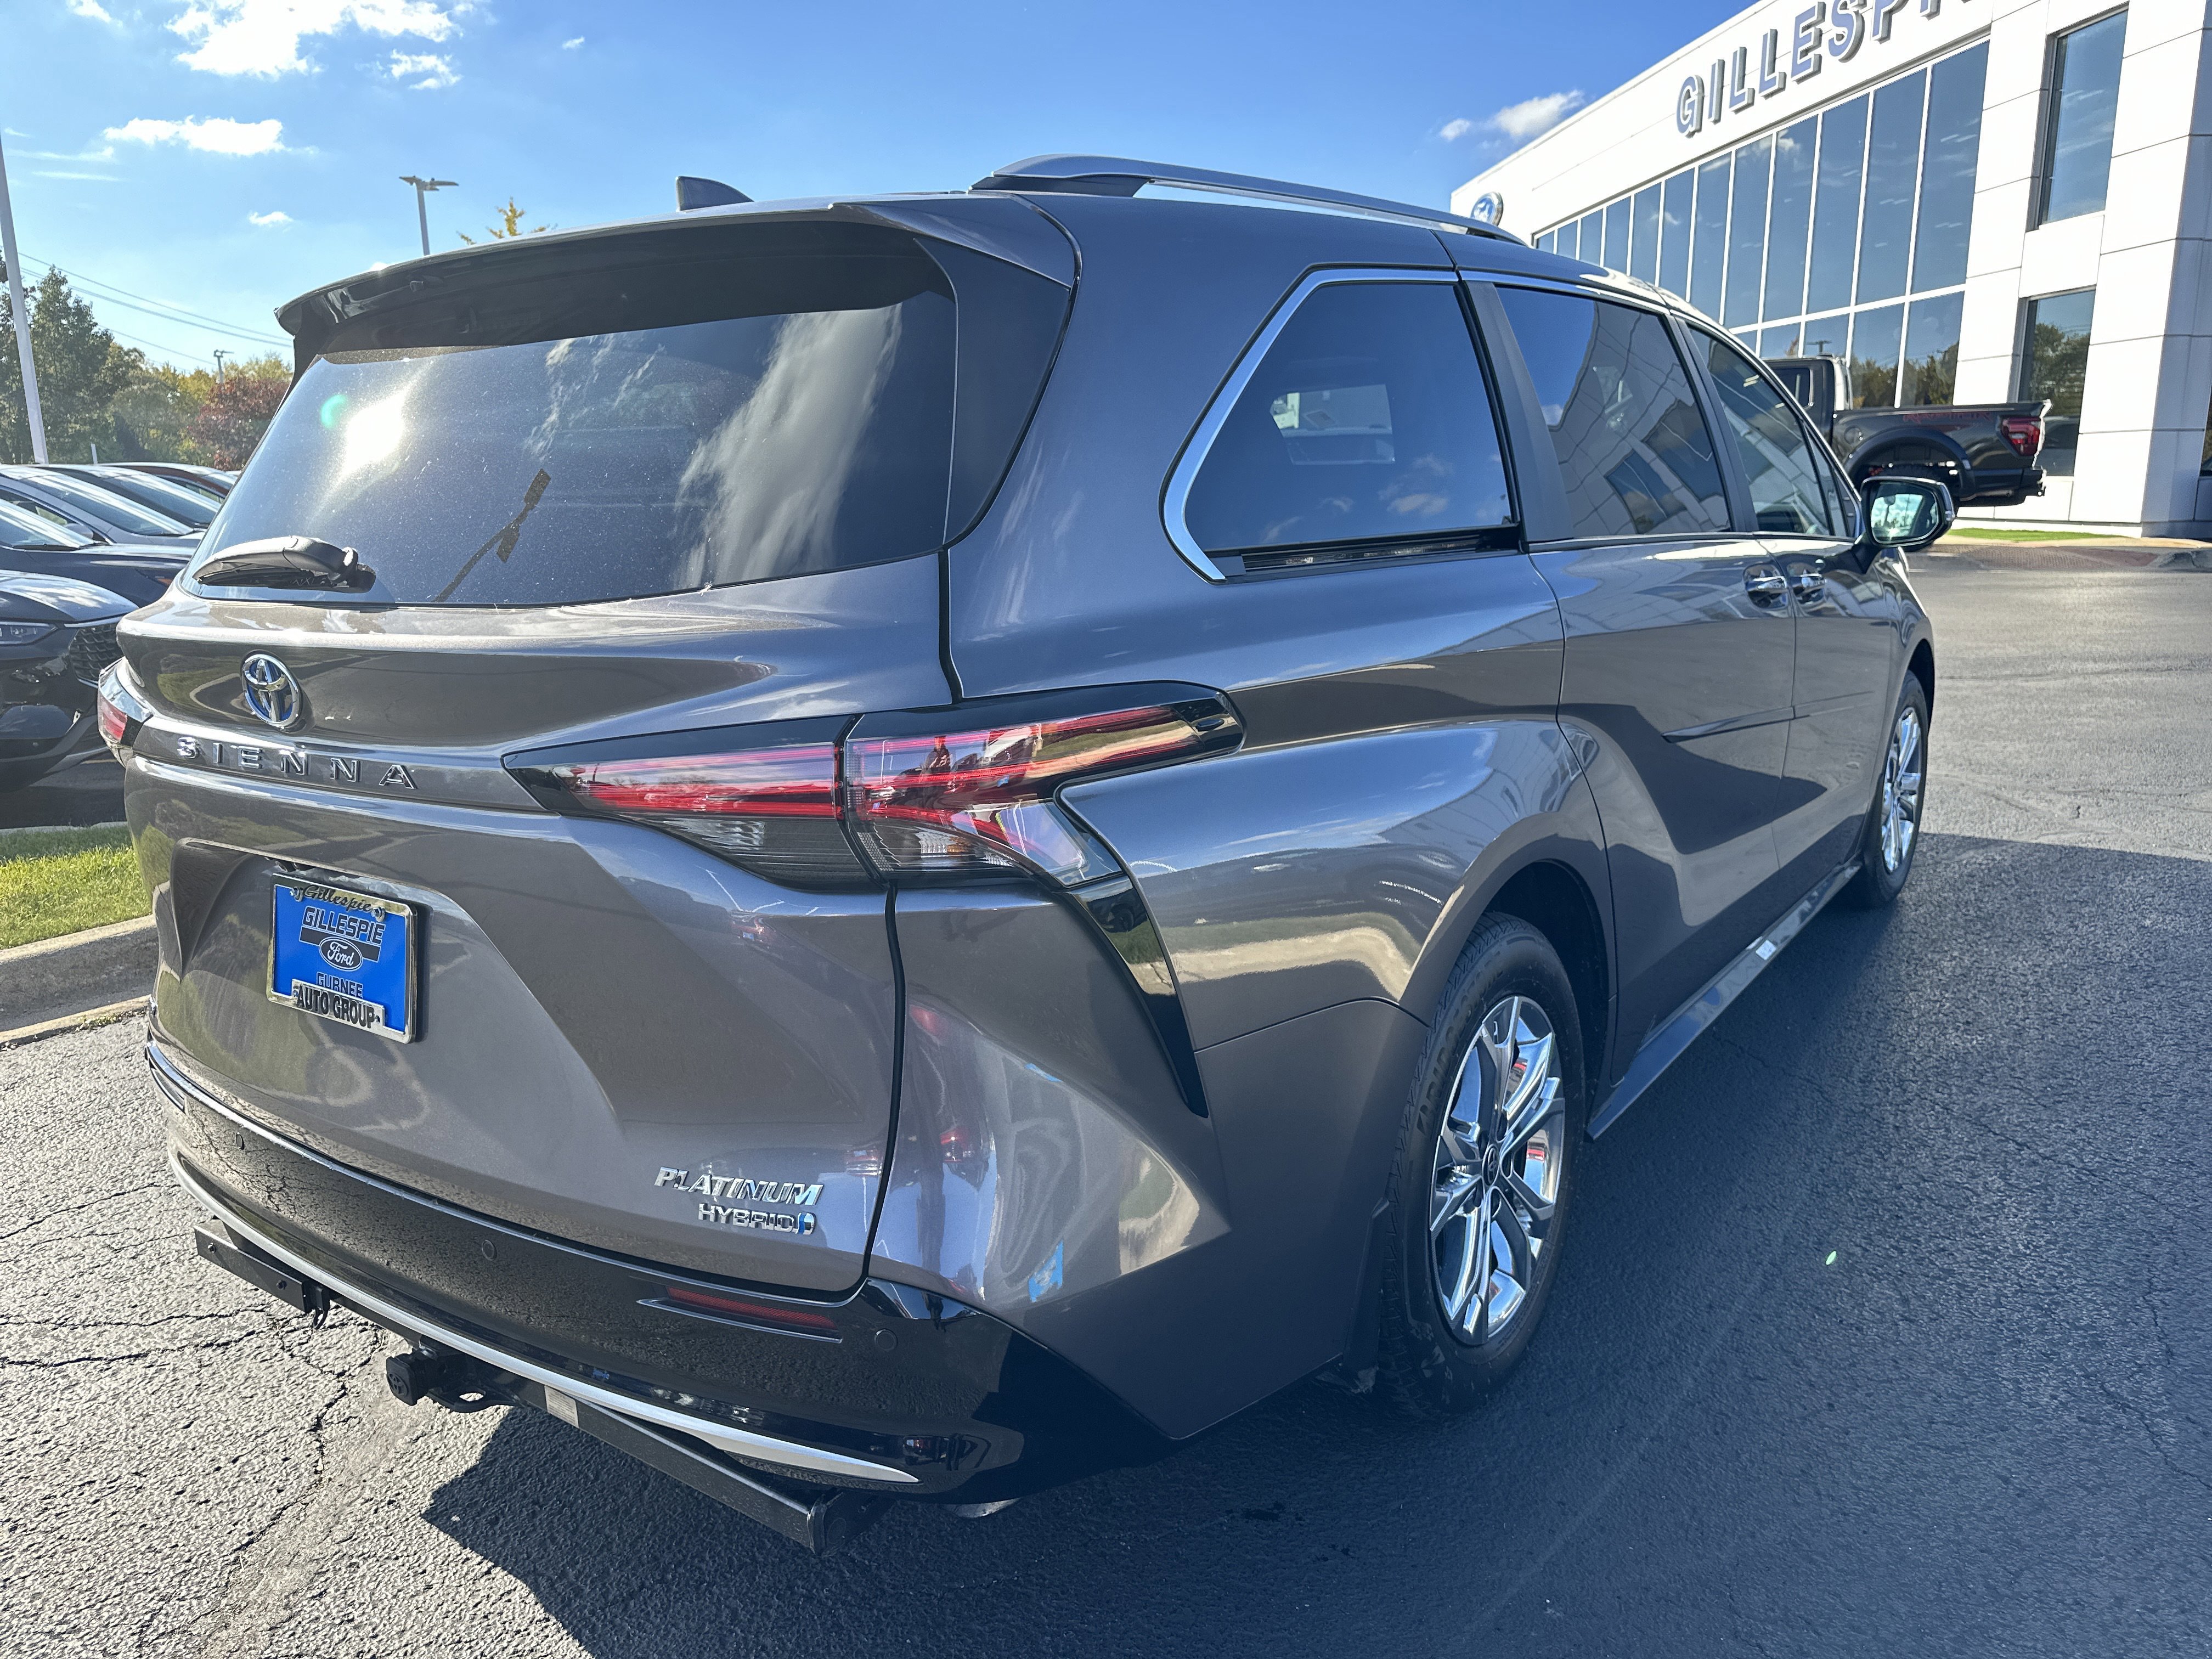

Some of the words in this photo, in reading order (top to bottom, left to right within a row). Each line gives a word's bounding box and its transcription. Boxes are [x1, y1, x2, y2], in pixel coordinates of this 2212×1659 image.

[1677, 0, 1972, 138] GILLESP
[177, 736, 417, 789] SIENNA
[303, 884, 373, 913] Gillespie
[302, 906, 386, 945] GILLESPIE
[327, 941, 354, 967] Ford
[316, 972, 364, 999] GURNEE
[296, 986, 330, 1015] AUTO
[332, 995, 376, 1029] GROUP
[653, 1166, 825, 1206] PLATINUM
[697, 1203, 795, 1233] HYBRID
